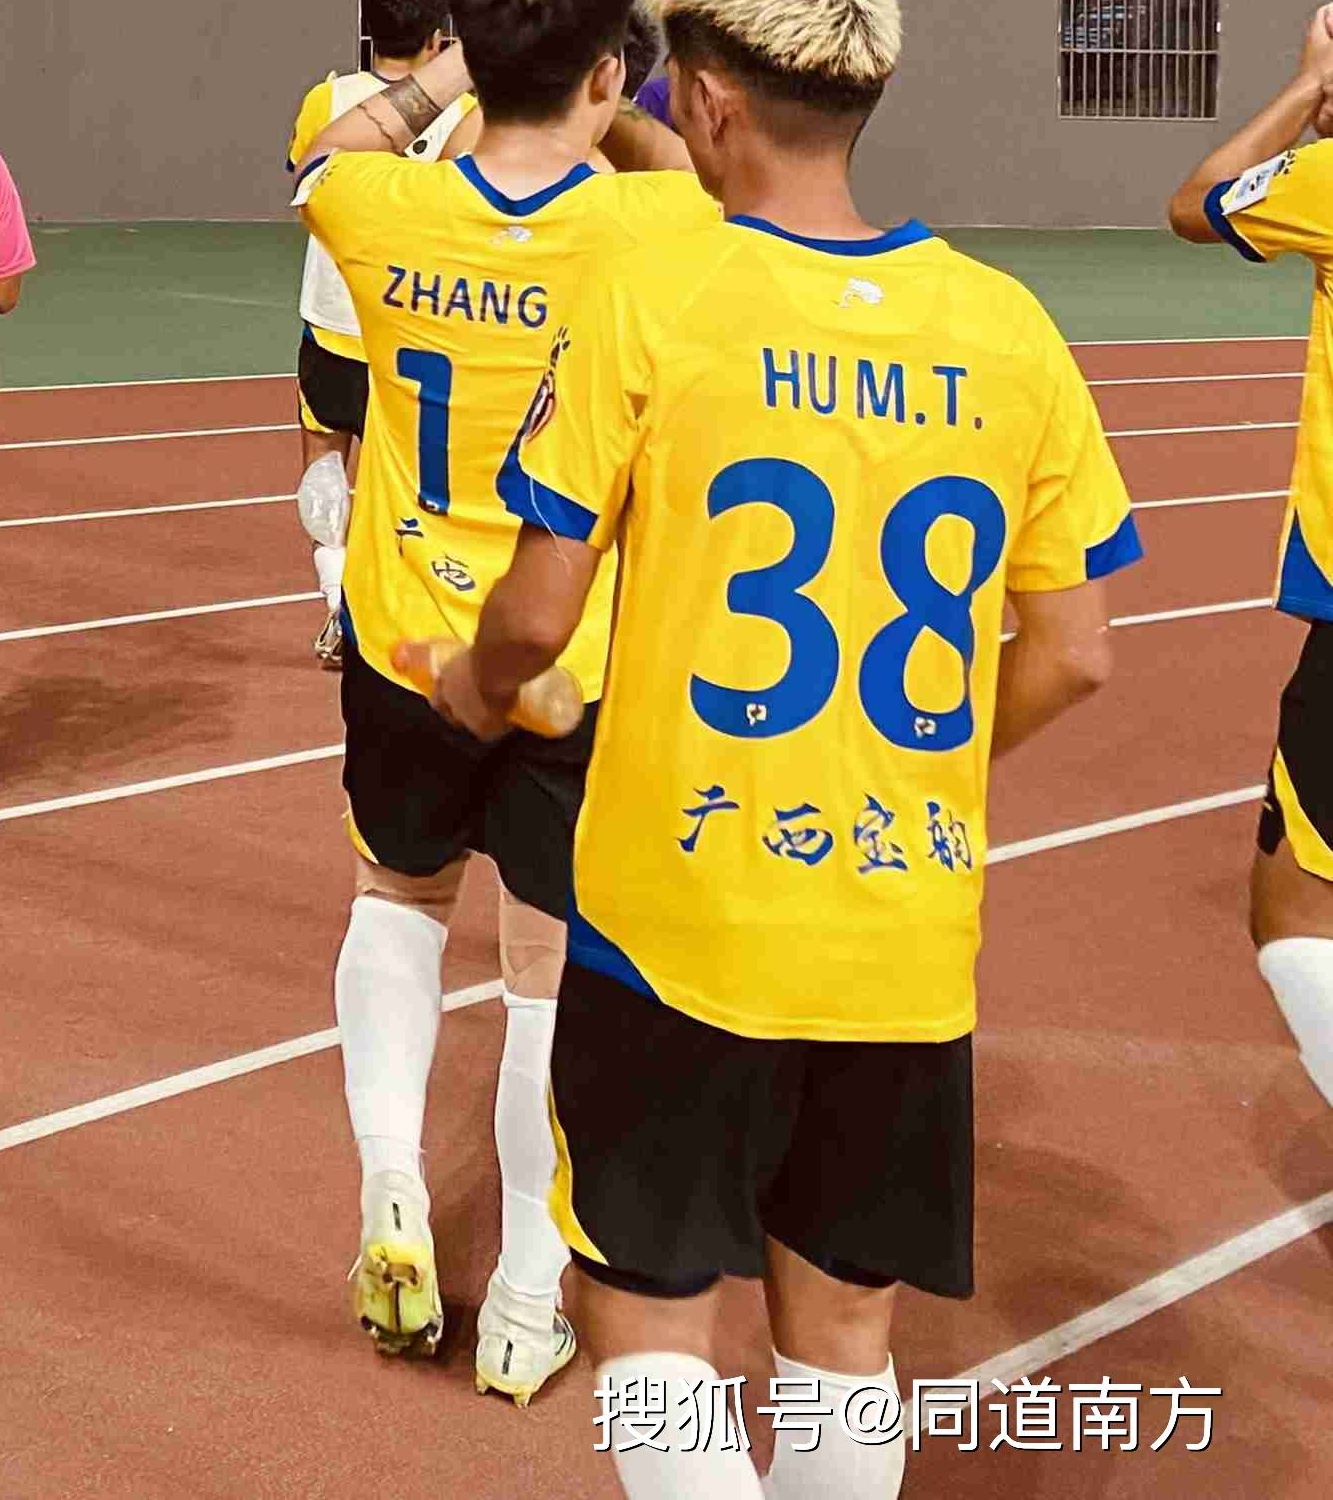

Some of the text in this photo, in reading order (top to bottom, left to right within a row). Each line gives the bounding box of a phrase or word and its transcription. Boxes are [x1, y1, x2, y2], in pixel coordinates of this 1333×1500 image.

[381, 264, 549, 329] ZHANG
[761, 347, 984, 431] HU M.T.
[689, 456, 1007, 752] 38
